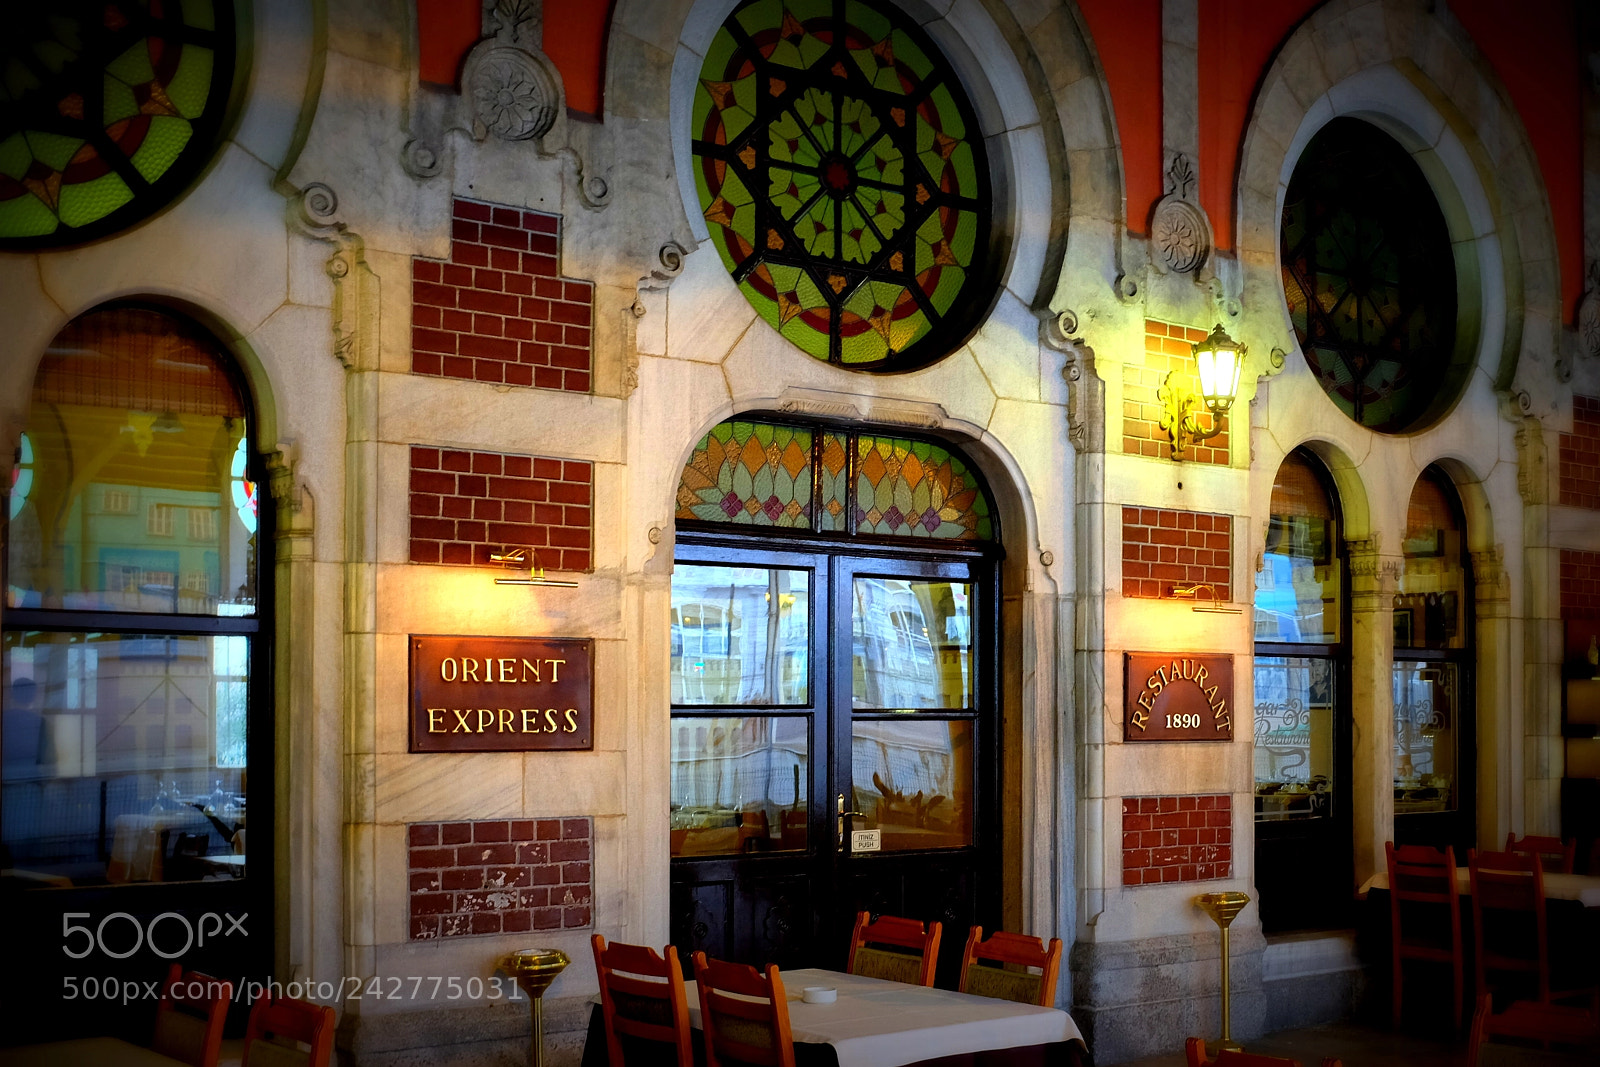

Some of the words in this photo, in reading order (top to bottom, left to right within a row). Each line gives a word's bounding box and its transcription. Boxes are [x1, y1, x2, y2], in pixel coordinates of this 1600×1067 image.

[441, 657, 566, 683] ORIENT
[1131, 658, 1231, 732] RESTAURANT
[427, 708, 578, 734] EXPRESS
[1165, 713, 1201, 729] 1890
